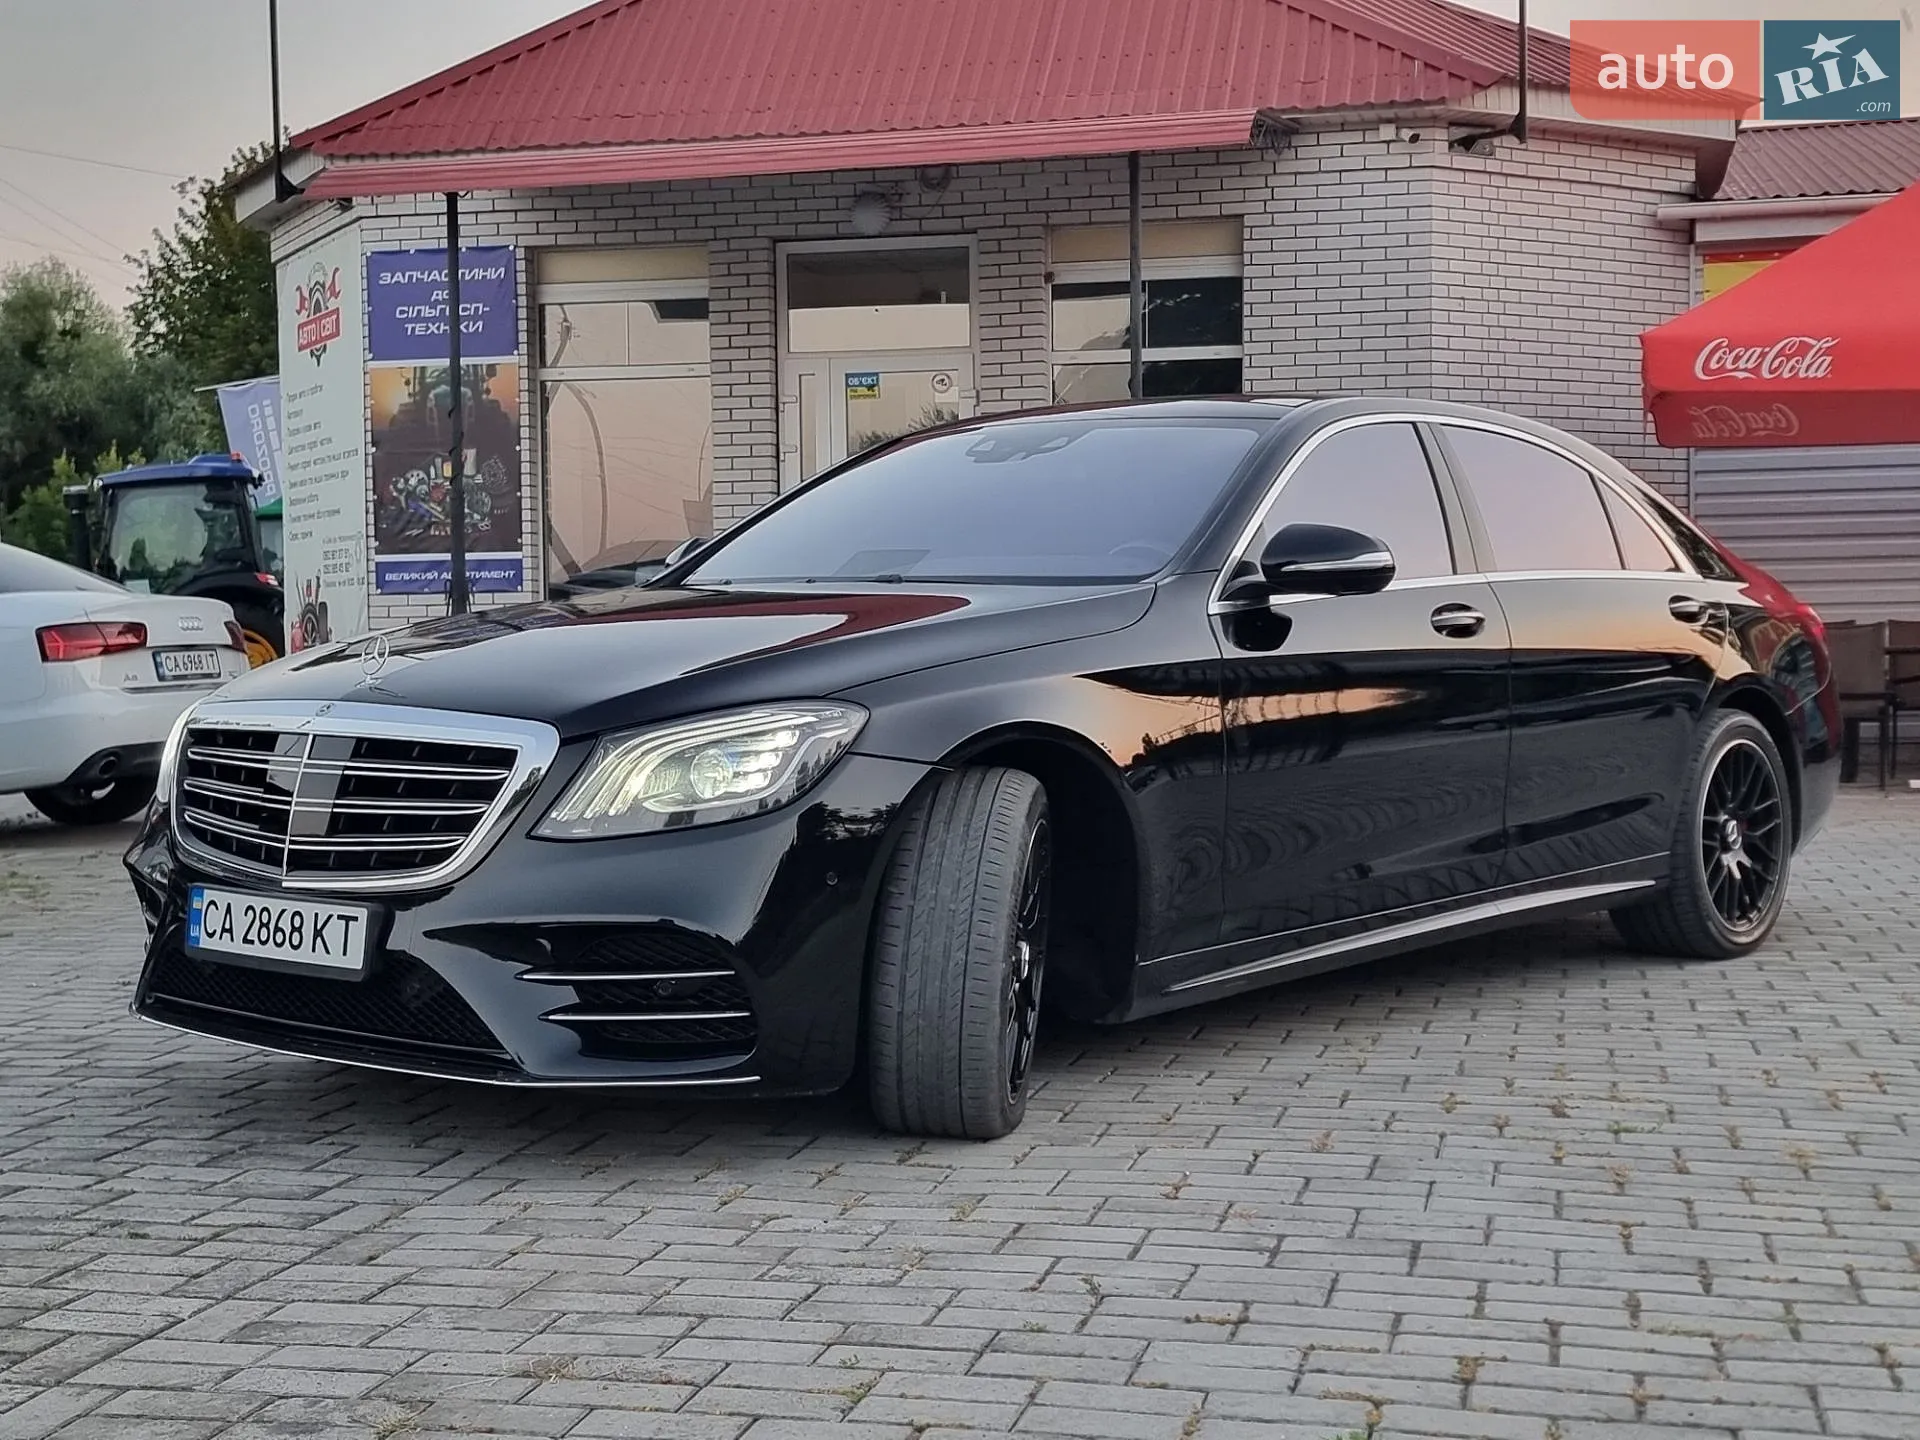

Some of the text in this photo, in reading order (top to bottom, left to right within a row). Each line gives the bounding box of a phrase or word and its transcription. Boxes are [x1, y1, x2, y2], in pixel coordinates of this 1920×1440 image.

[395, 303, 490, 319] СІЛЬГСП-
[299, 314, 337, 345] АВТО СВІТ
[404, 320, 483, 336] ТЕХНКИ
[1694, 337, 1840, 380] Coca-Cola
[384, 570, 516, 581] ВЕЛИКИЙ АТИМЕНТ
[164, 655, 182, 673] CA
[182, 654, 204, 672] 6968
[203, 899, 359, 957] CA 2868 KT
